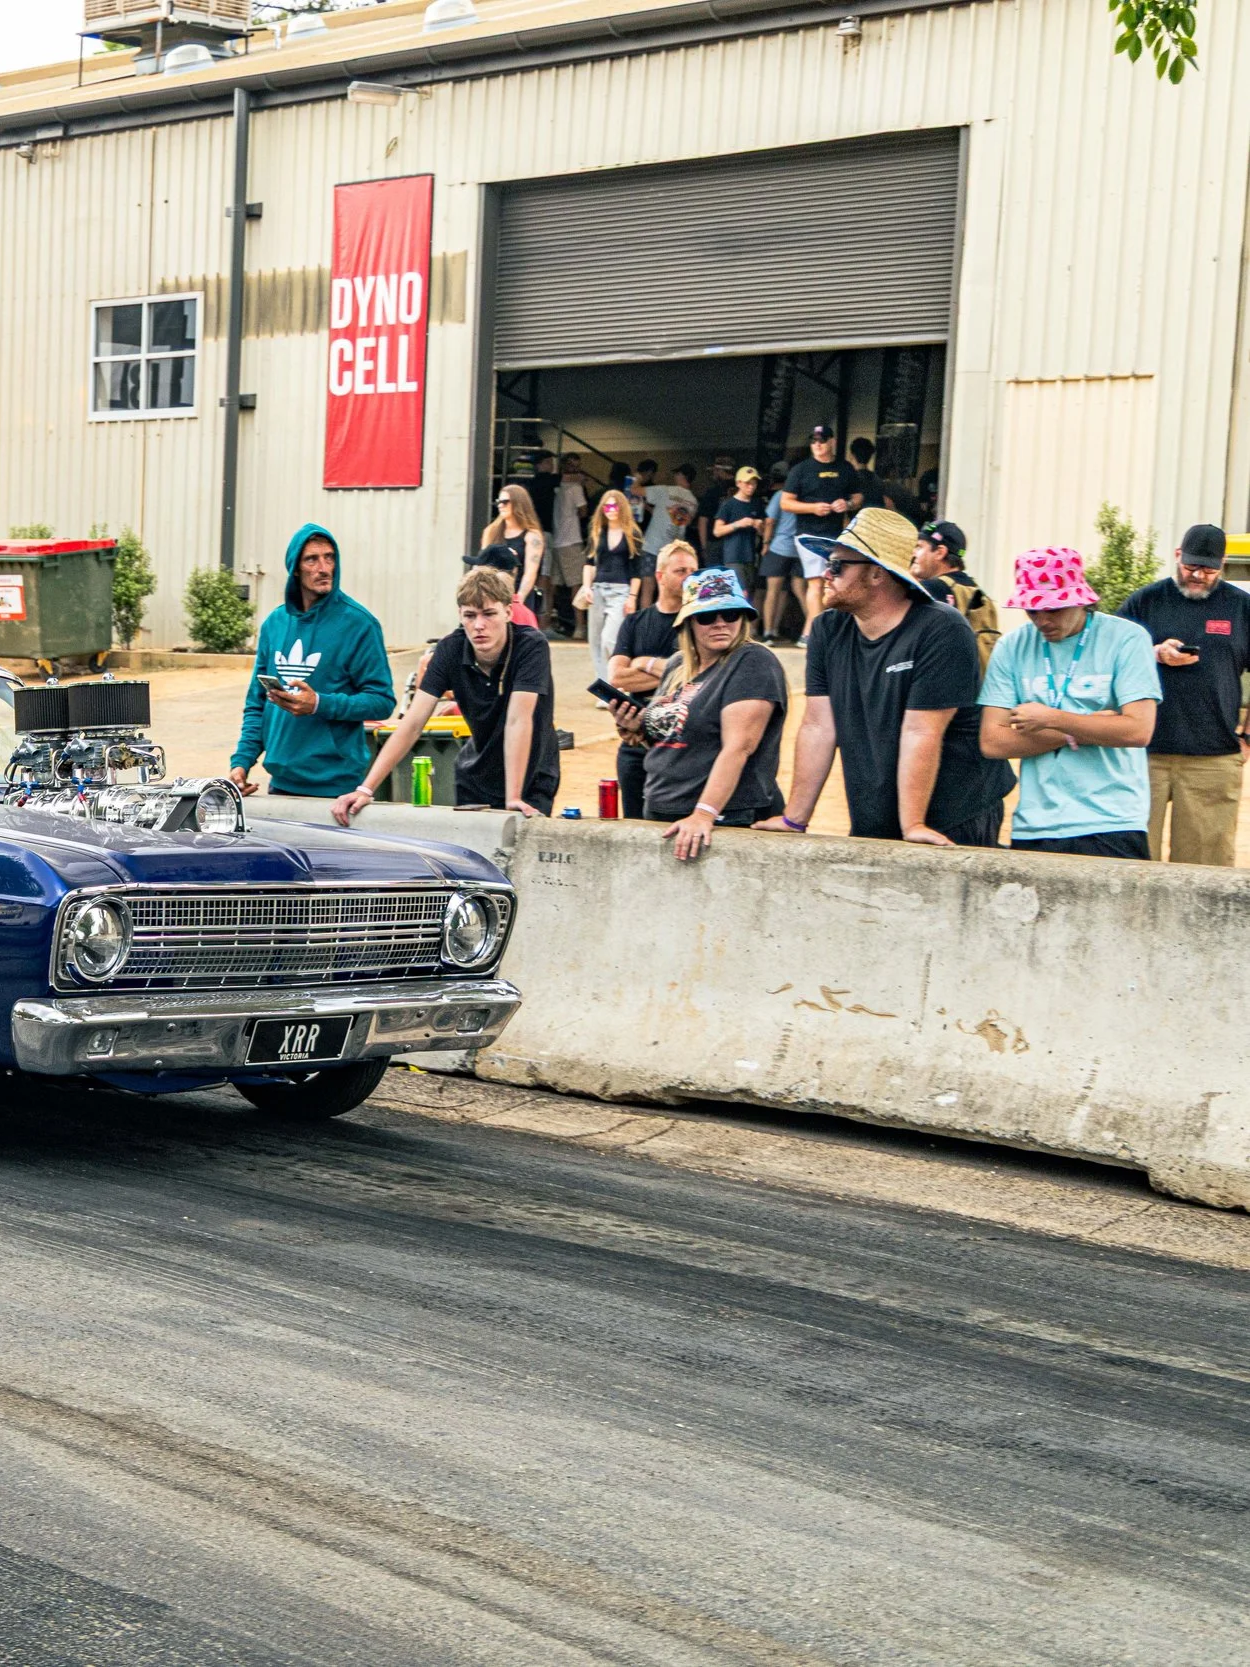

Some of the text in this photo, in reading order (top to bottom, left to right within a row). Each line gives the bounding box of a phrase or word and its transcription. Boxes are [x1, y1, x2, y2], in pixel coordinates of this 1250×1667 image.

[330, 272, 422, 330] DYNO
[329, 335, 418, 396] CELL
[277, 1024, 321, 1054] XRR
[279, 1052, 310, 1061] VICTORIA
